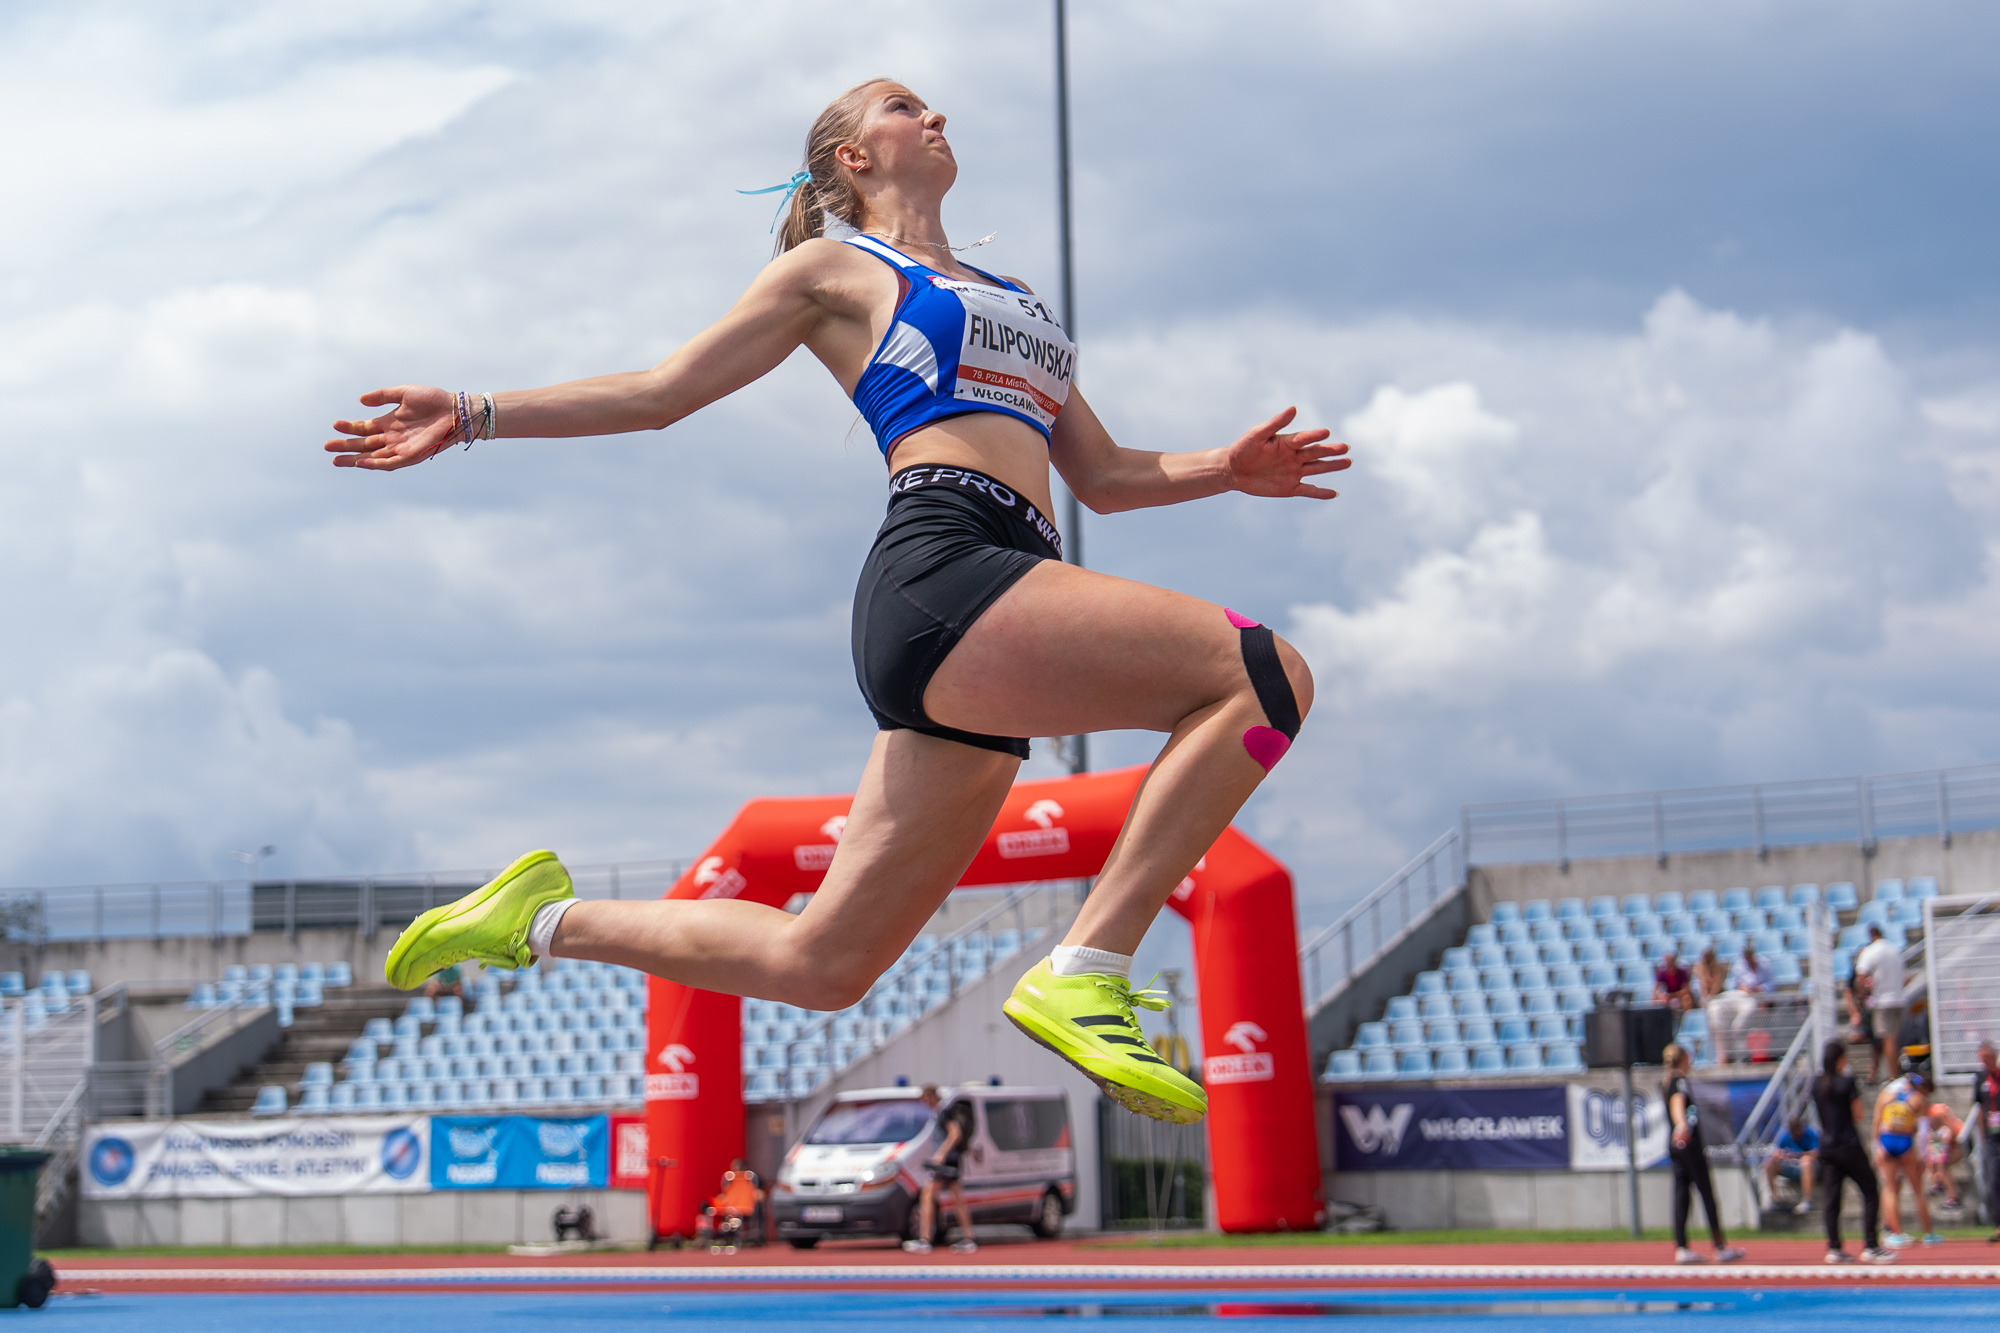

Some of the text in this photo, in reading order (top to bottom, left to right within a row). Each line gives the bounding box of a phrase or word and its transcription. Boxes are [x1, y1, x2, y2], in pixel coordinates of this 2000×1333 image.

[969, 313, 1072, 386] FILIPOWSKA
[972, 369, 984, 380] 79.
[985, 372, 1004, 384] PZLA
[930, 468, 1016, 507] PRO
